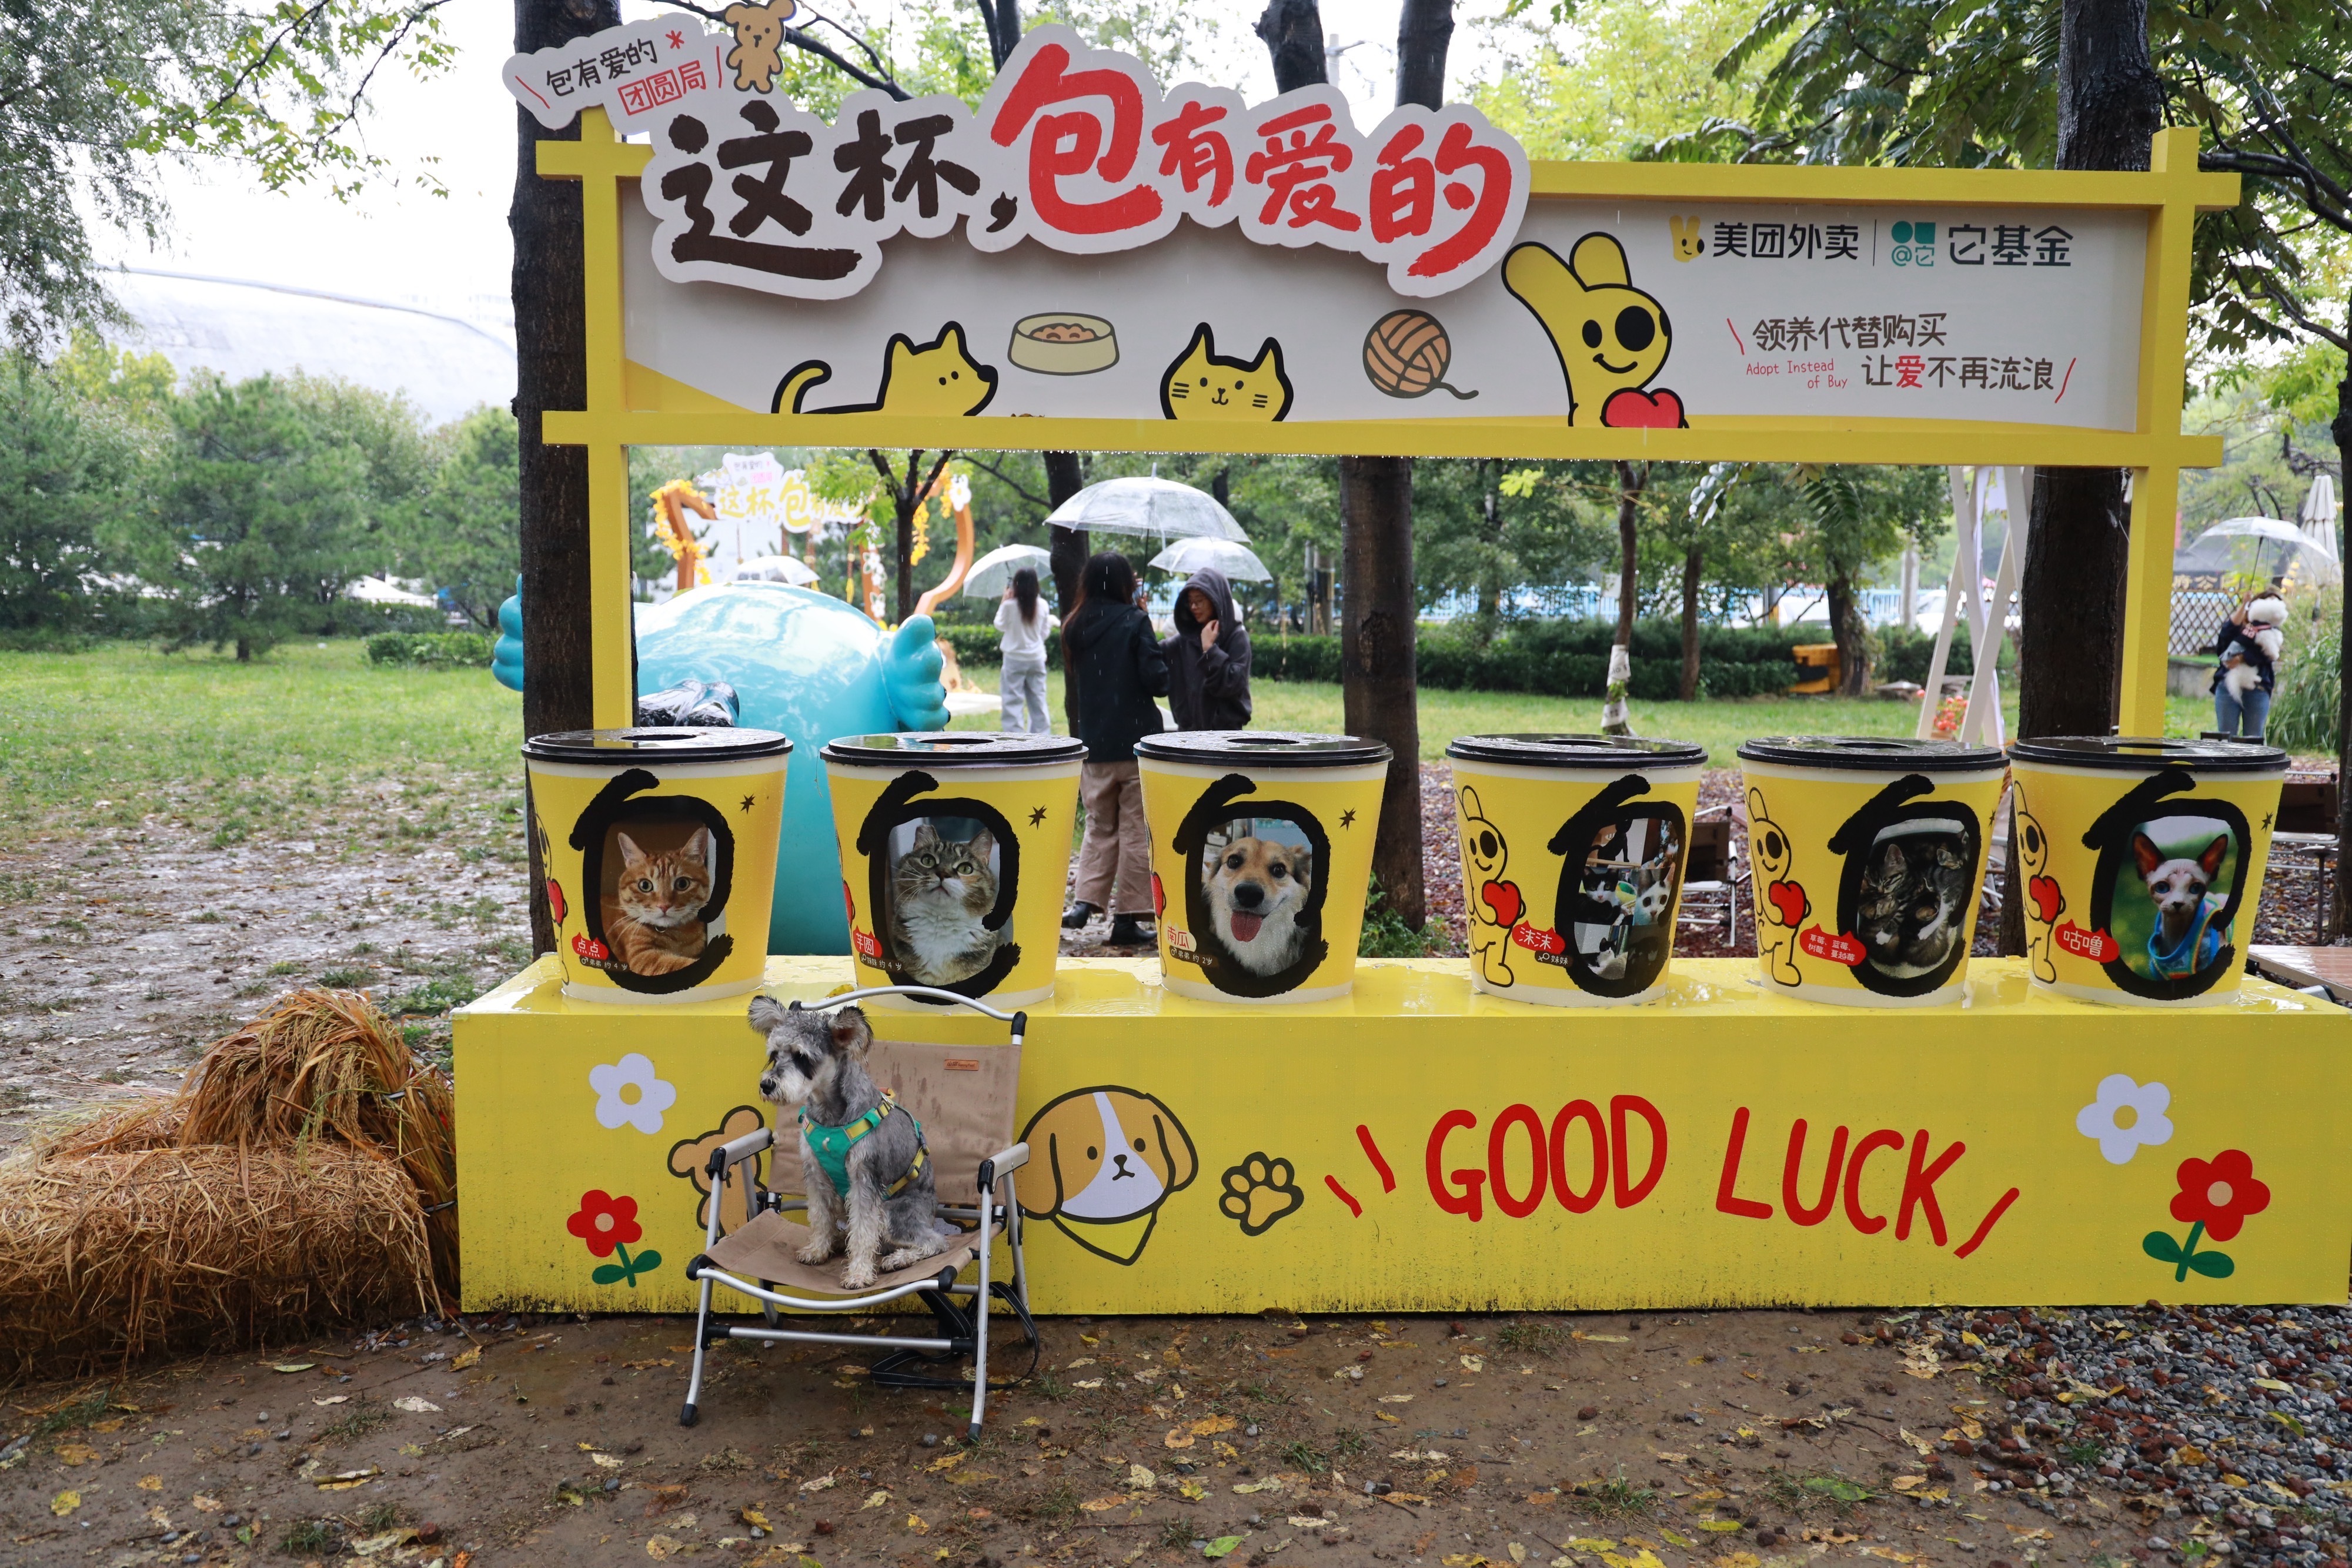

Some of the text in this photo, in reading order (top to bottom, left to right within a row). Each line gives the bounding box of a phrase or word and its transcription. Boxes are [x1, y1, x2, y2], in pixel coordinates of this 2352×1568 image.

[547, 39, 657, 96] 包有爱的
[618, 60, 706, 116] 团圆局
[1713, 222, 1858, 260] 美团外卖
[1949, 224, 2073, 266] 它基金
[1753, 313, 1947, 351] 领养代替购买
[1746, 358, 1834, 376] Adopt Instead
[1862, 355, 2054, 391] 让爱不再流浪
[1807, 375, 1848, 389] of Buy
[577, 938, 600, 958] 点点
[856, 932, 874, 955] 芋圆
[1168, 926, 1190, 949] 南瓜
[1519, 927, 1552, 950] 沫沫
[2063, 930, 2103, 957] 咕噜
[1551, 955, 1568, 965] 妹妹
[1425, 1095, 1966, 1247] GOOD LUCK
